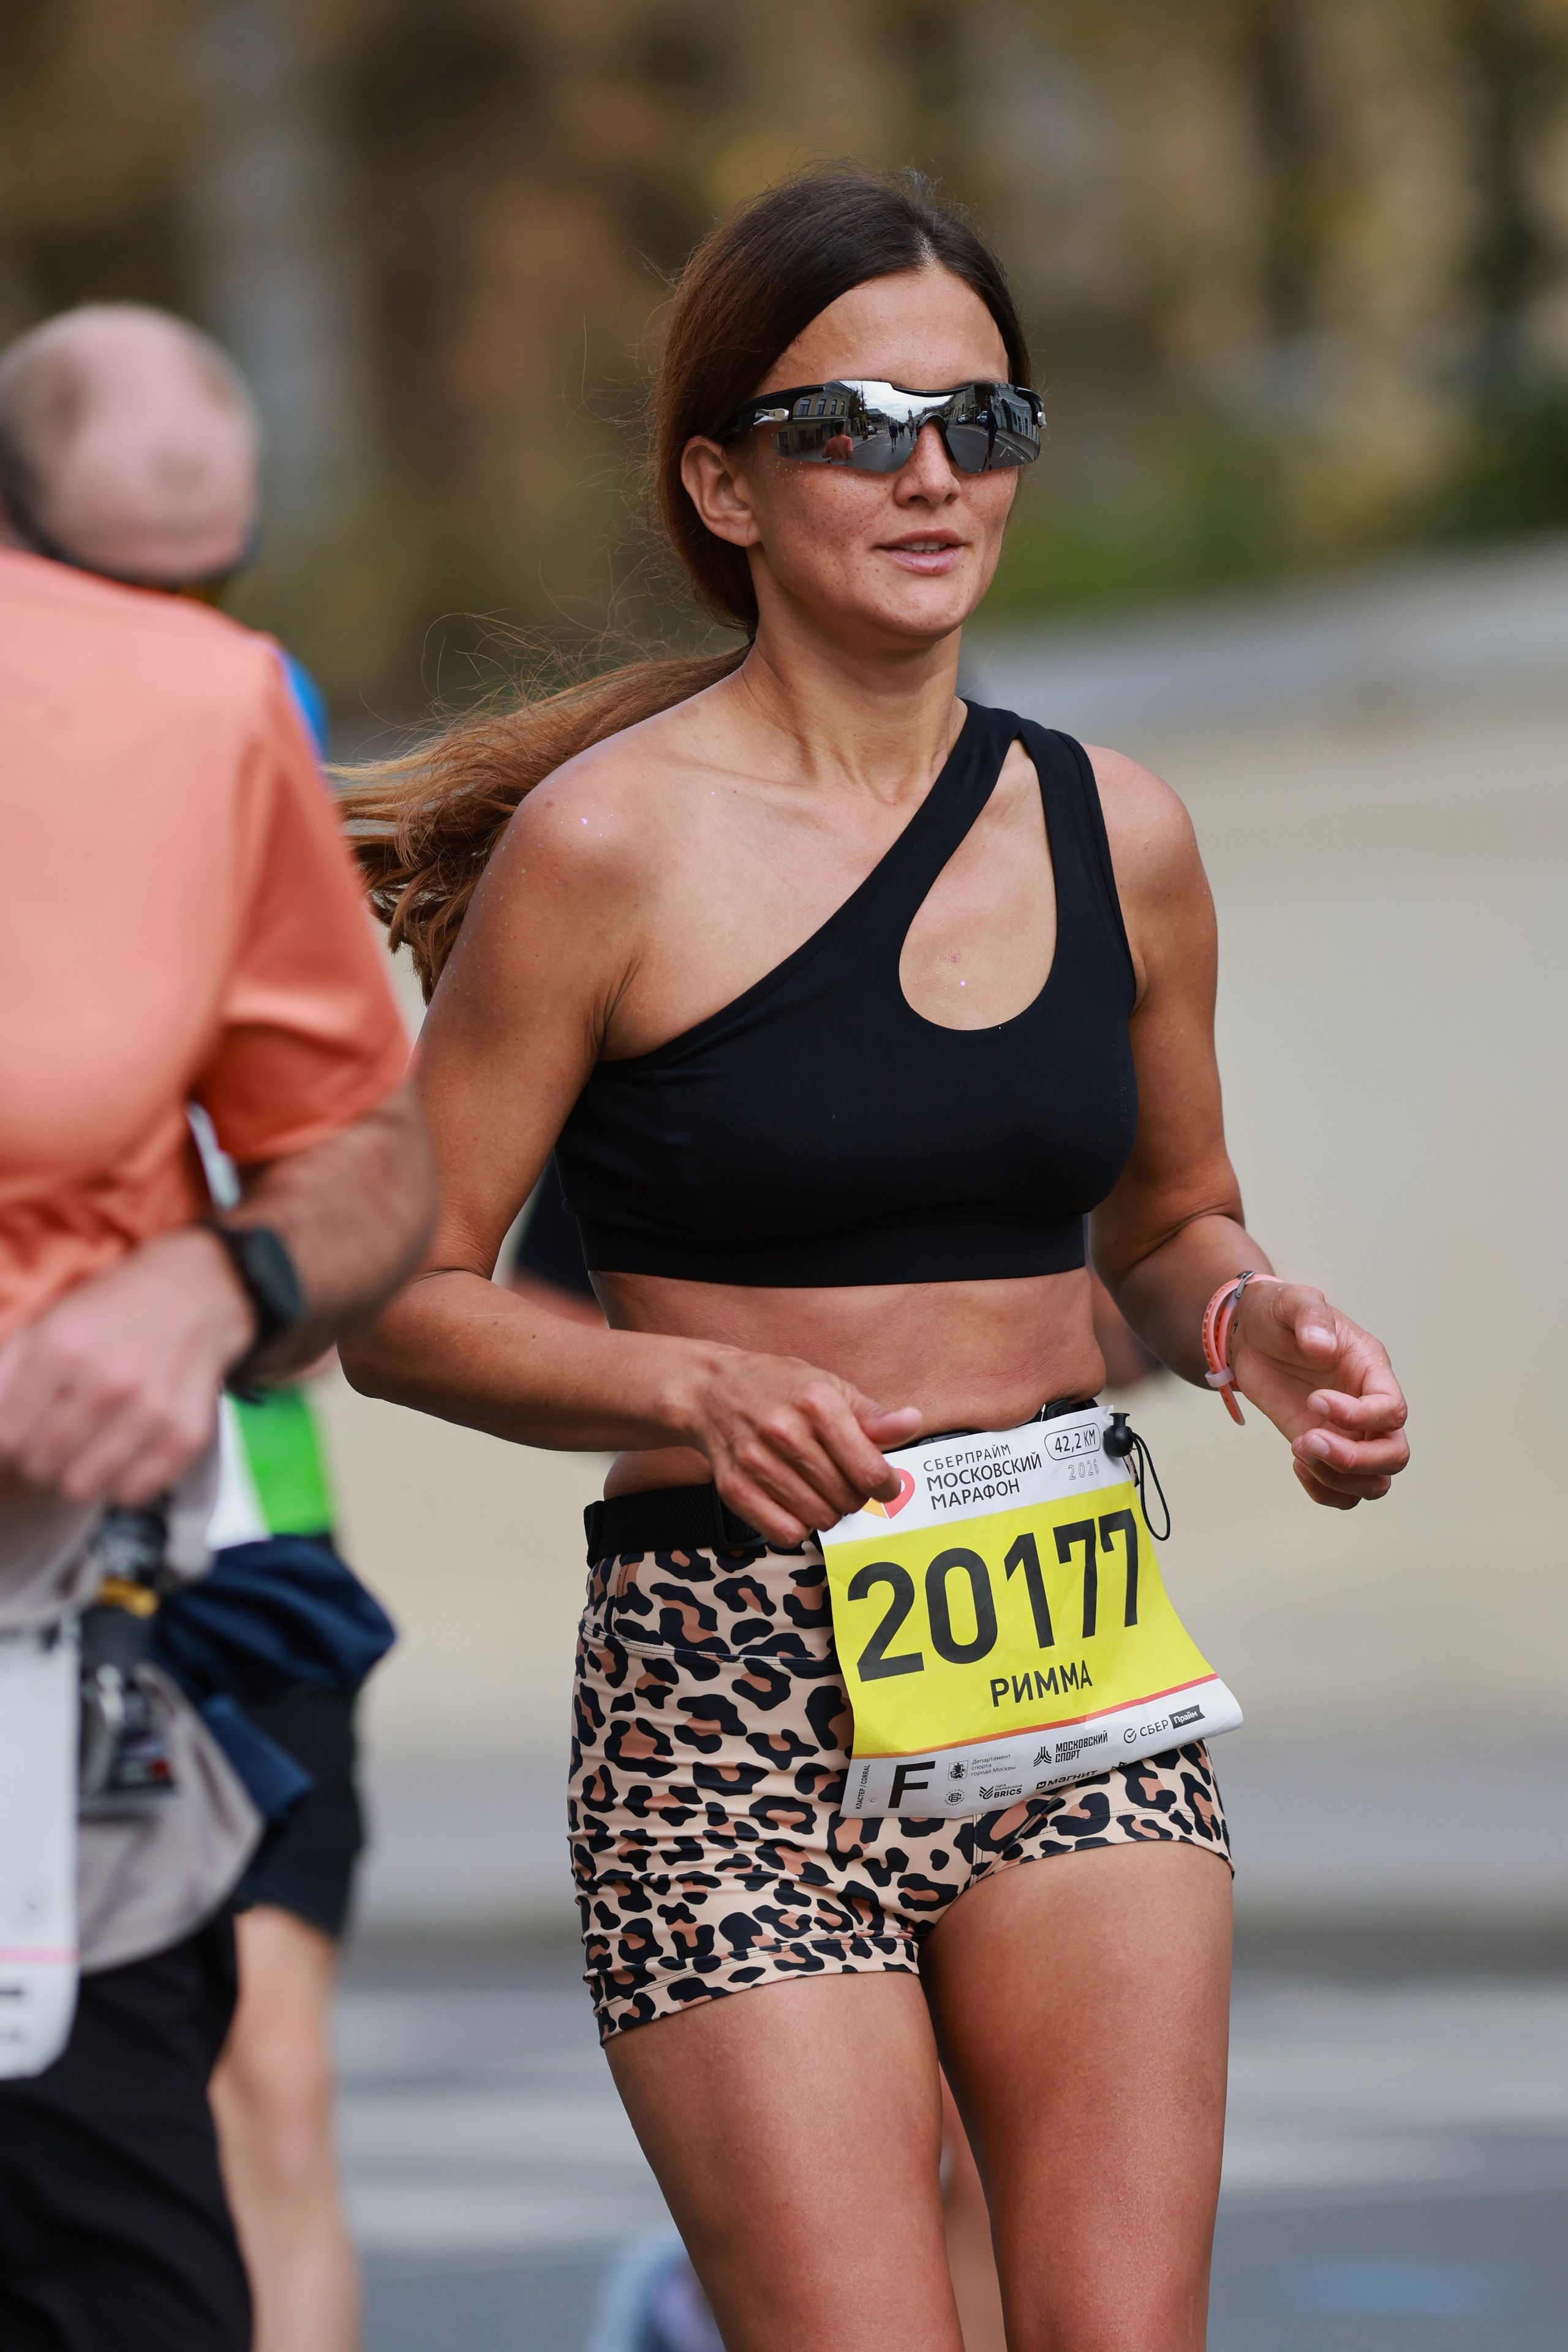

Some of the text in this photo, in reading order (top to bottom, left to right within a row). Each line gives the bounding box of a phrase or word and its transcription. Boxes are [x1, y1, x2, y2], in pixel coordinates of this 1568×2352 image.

[1055, 1433, 1082, 1453] 42,2
[923, 1444, 1011, 1472] СБЕРПРАЙМ
[926, 1451, 1042, 1491] МОСКОВСКИЙ
[930, 1478, 1020, 1510] МАРАФОН
[847, 1508, 1138, 1683] 20177
[990, 1660, 1093, 1707] РИММА
[1140, 1711, 1198, 1736] СБЕР Прайм
[1055, 1730, 1108, 1753] МОСКОВСКИЙ
[971, 1754, 1011, 1765] Департамент
[1055, 1749, 1080, 1763] СПОРТ
[855, 1788, 865, 1809] КЛАСТЕР
[861, 1764, 870, 1784] CORRAL
[888, 1760, 935, 1809] F
[994, 1788, 1022, 1798] BRICS
